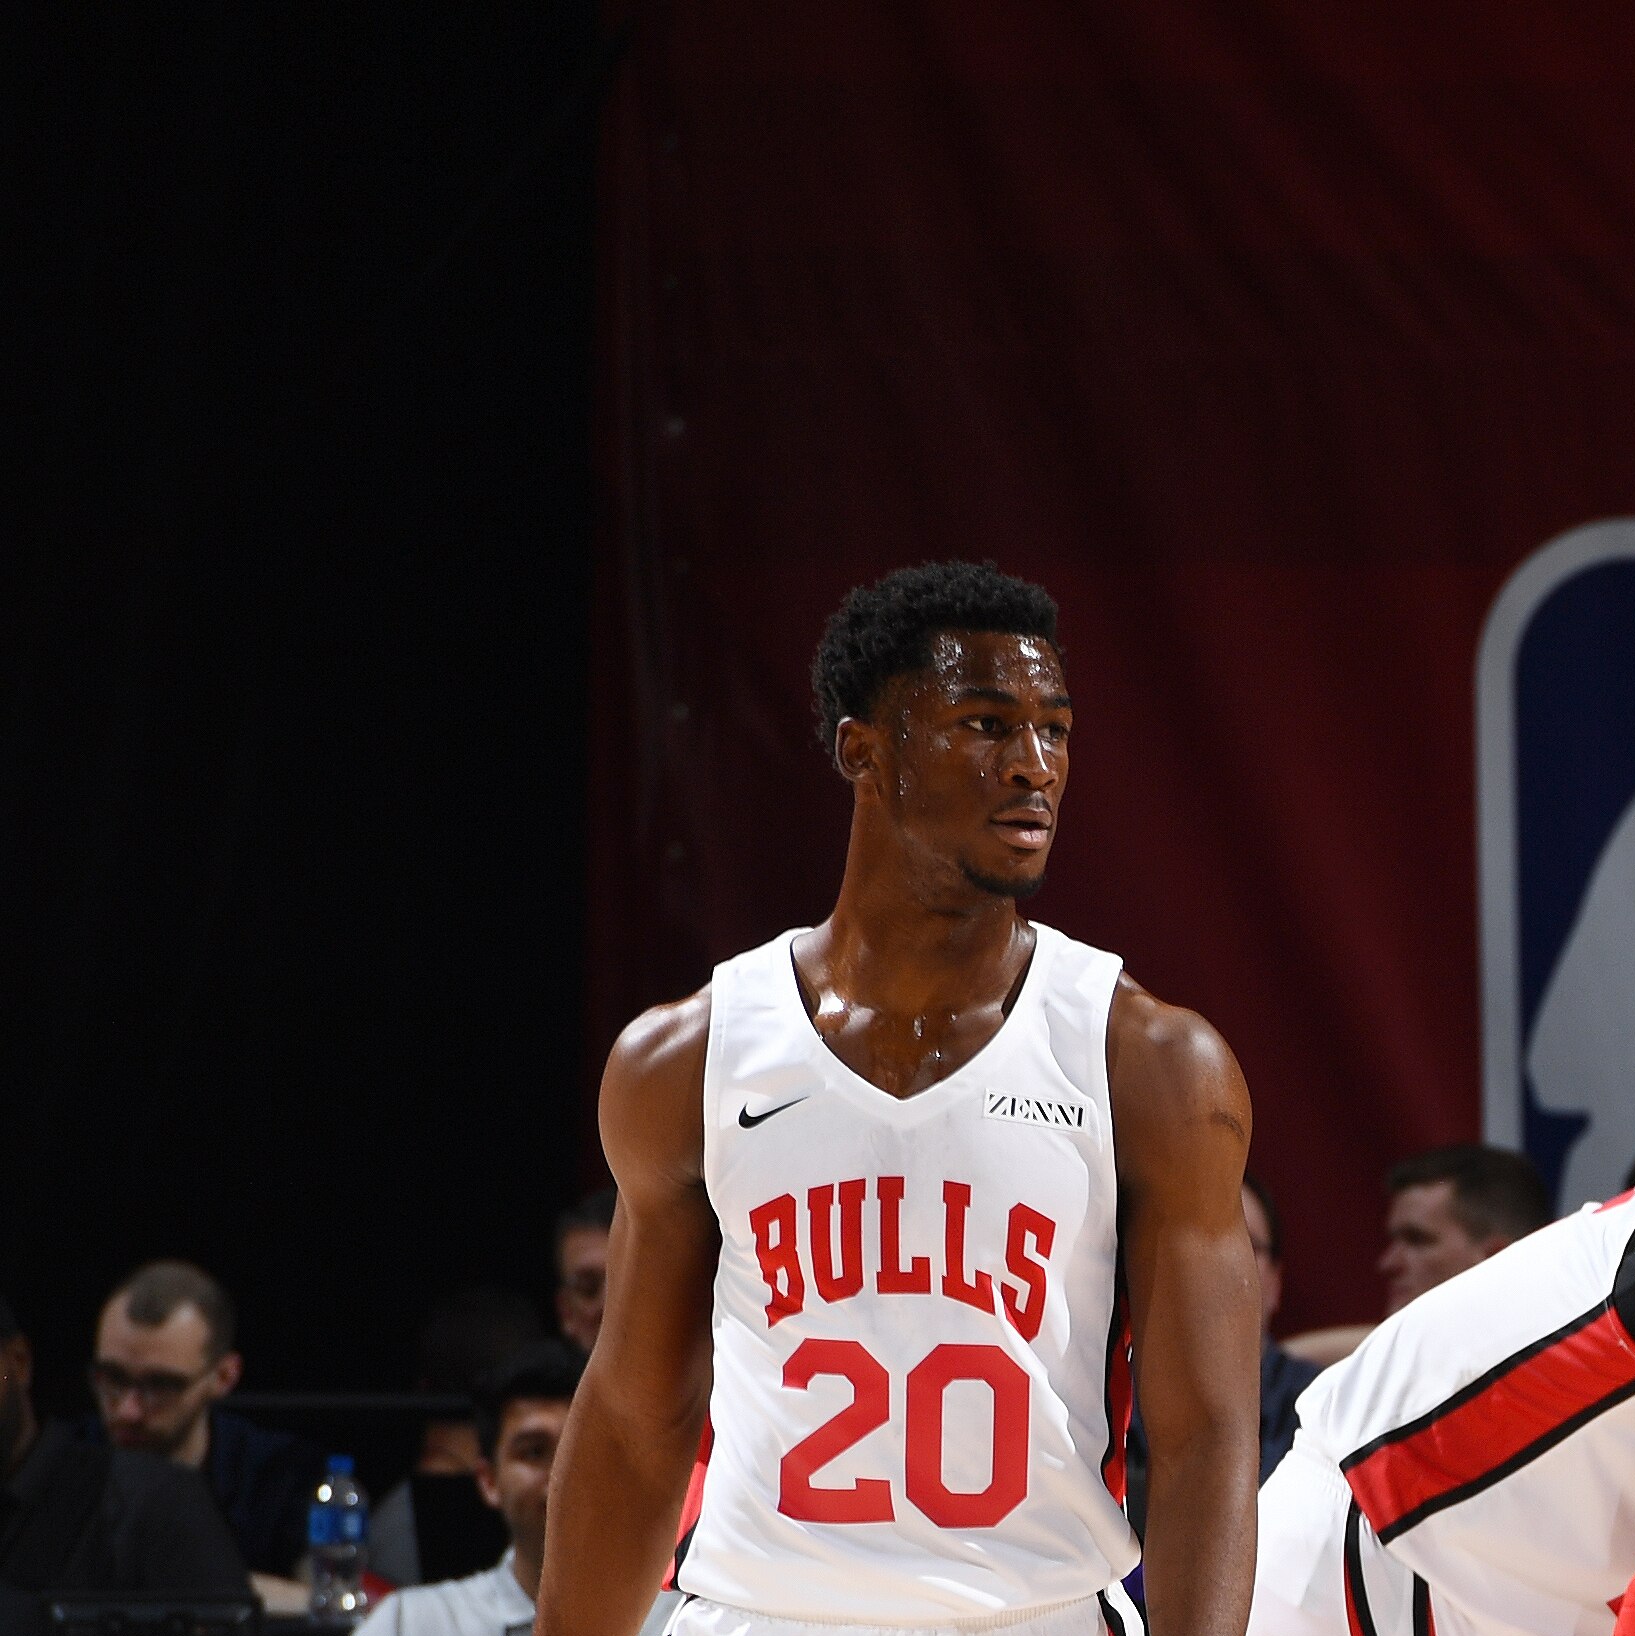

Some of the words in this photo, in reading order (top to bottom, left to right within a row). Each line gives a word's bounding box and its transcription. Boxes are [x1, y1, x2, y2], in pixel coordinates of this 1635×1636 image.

[988, 1093, 1084, 1128] ZENNI
[748, 1176, 1057, 1342] BULLS
[777, 1337, 1031, 1529] 20
